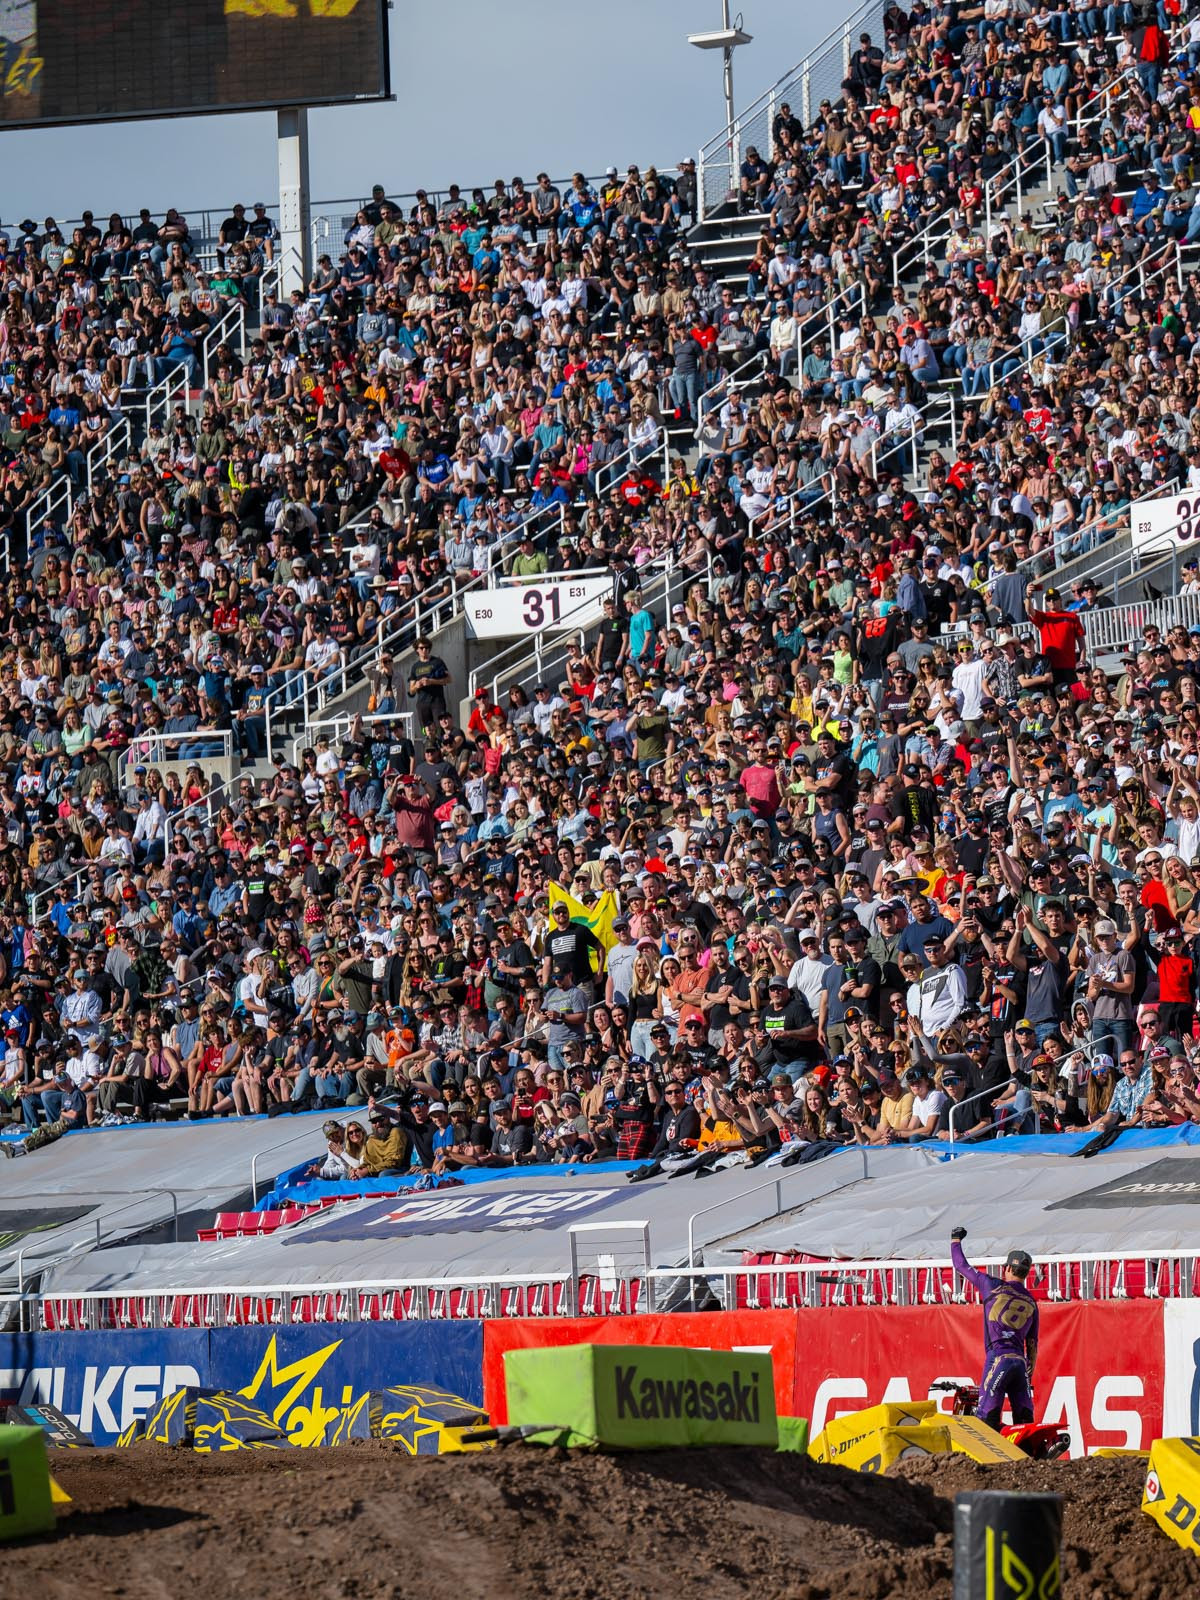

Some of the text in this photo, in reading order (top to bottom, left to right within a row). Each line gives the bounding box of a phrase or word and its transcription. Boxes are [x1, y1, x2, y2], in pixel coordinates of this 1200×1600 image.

[1138, 521, 1152, 533] E32
[523, 587, 561, 628] 31
[569, 587, 586, 598] E31
[475, 609, 493, 620] E30
[865, 617, 888, 640] 18
[363, 1188, 621, 1226] FALKEN
[988, 1293, 1035, 1330] 18
[614, 1365, 760, 1424] Kawasaki
[37, 1407, 77, 1440] GoPro
